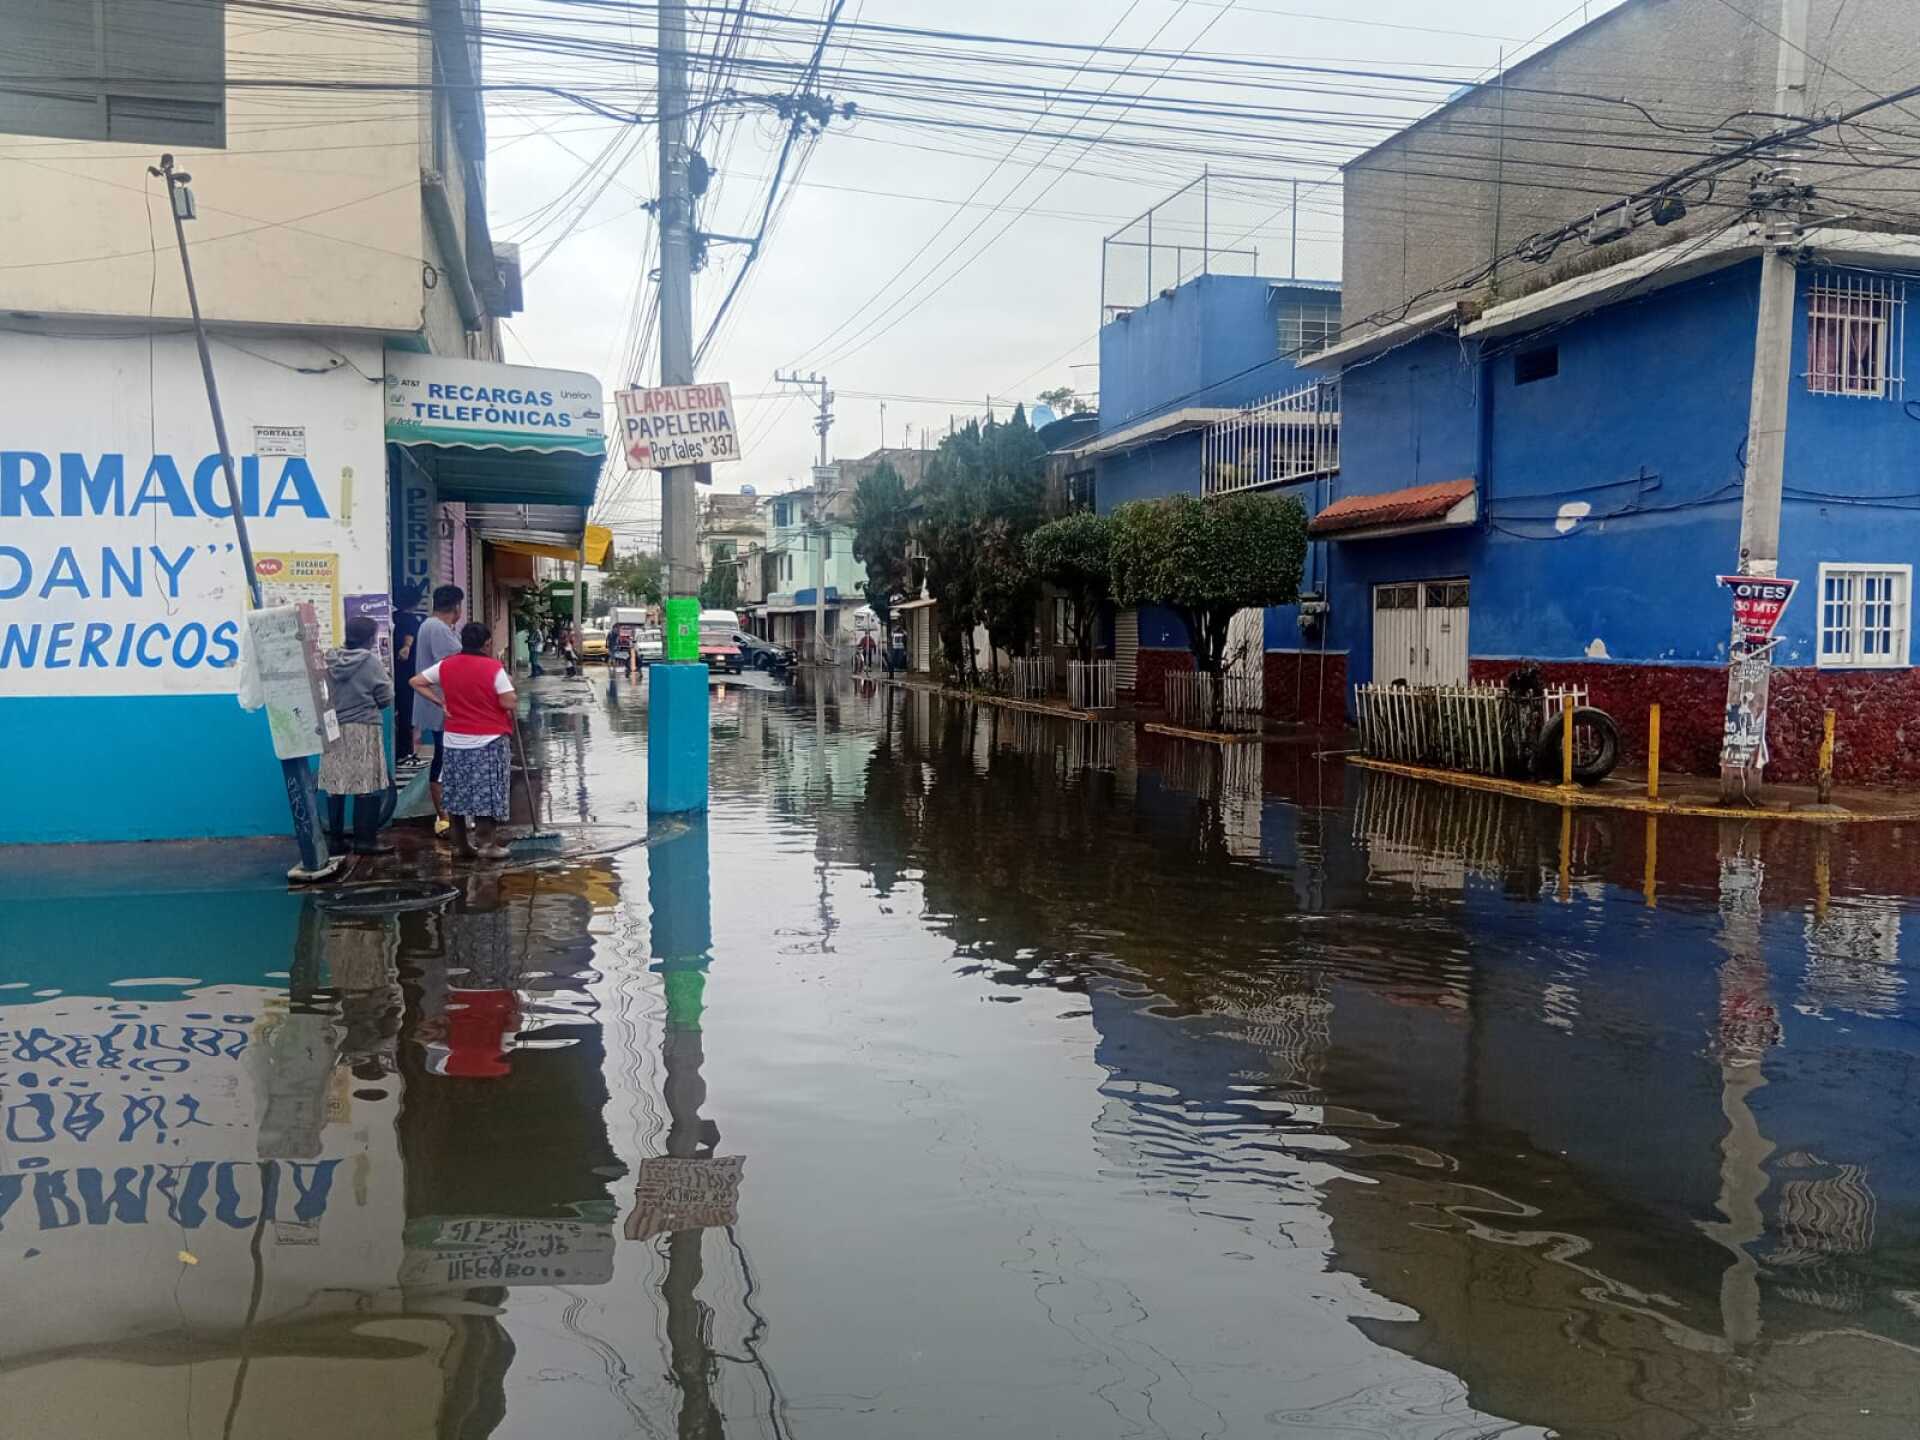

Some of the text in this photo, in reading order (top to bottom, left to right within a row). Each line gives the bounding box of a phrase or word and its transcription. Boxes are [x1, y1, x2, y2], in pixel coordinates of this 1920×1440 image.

[401, 379, 420, 387] AT&T
[428, 384, 553, 406] RECARGAS
[620, 386, 726, 414] TLAPALERIA
[626, 410, 731, 440] PAPELERIA
[651, 438, 704, 462] Portales
[0, 451, 331, 518] RMACIA
[1737, 584, 1786, 600] OTES
[0, 621, 239, 669] NERICOS
